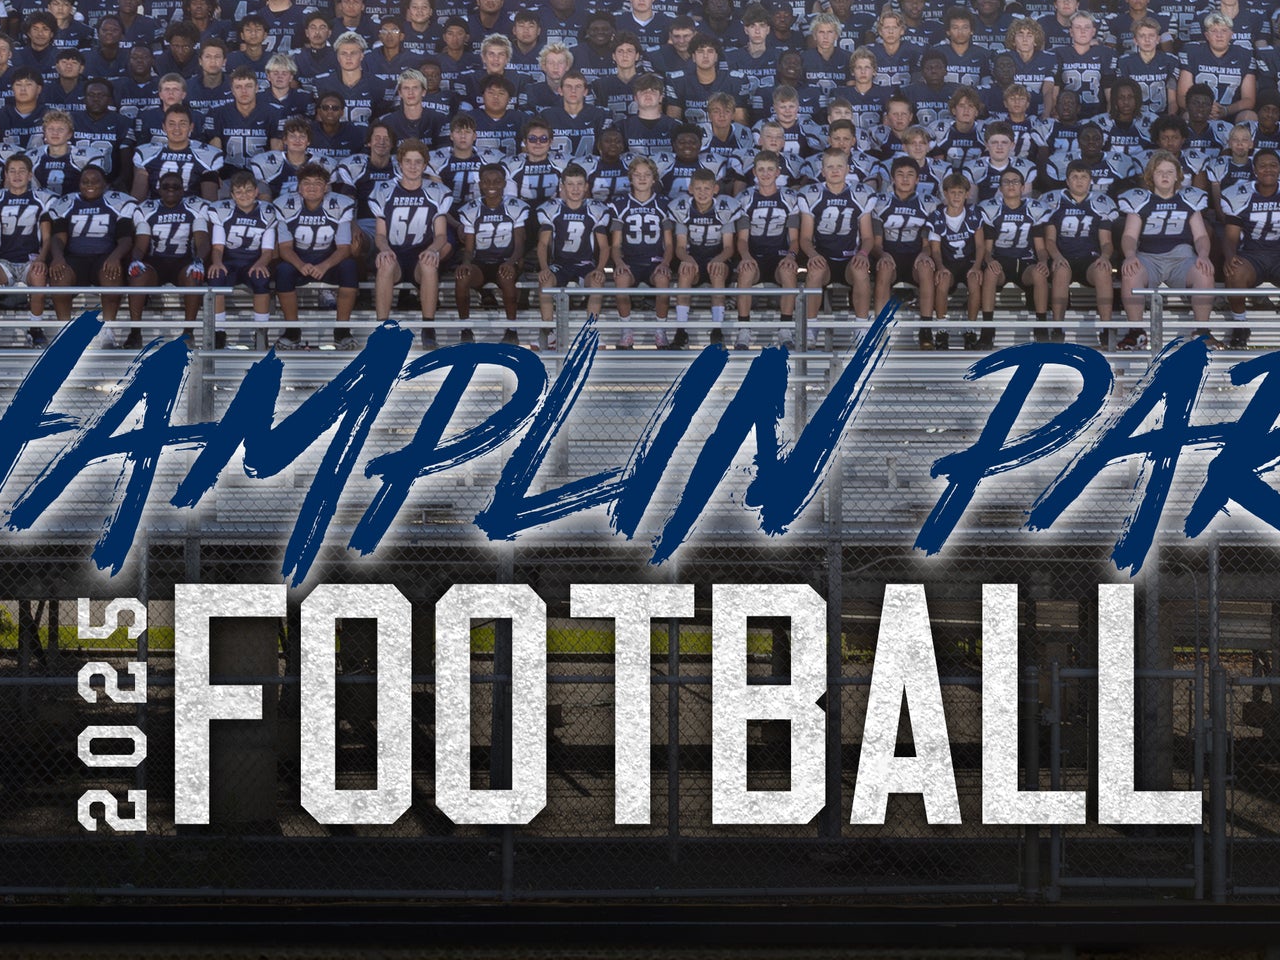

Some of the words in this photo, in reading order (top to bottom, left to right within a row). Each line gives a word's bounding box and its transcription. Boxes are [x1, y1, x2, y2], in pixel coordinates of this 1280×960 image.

[74, 131, 99, 140] CHAMPLIN
[100, 132, 117, 140] PARK
[224, 128, 251, 136] CHAMPLIN
[254, 128, 267, 136] PARK
[1111, 136, 1139, 145] REBELS
[161, 152, 192, 162] REBELS
[451, 162, 481, 171] REBELS
[524, 164, 551, 174] REBELS
[8, 198, 30, 206] REBELS
[394, 196, 424, 205] REBELS
[757, 199, 778, 207] REBELS
[629, 207, 655, 215] REBELS
[1, 206, 38, 236] 54
[158, 214, 186, 223] REBELS
[236, 217, 257, 226] REBELS
[300, 215, 326, 224] REBELS
[563, 213, 584, 221] REBELS
[1004, 214, 1024, 222] REBELS
[72, 214, 110, 237] 75
[388, 207, 428, 244] 64
[1143, 212, 1187, 235] 55
[625, 215, 661, 244] 33
[153, 223, 190, 254] 74
[226, 226, 264, 250] 57
[562, 222, 584, 251] 3
[995, 223, 1031, 248] 21
